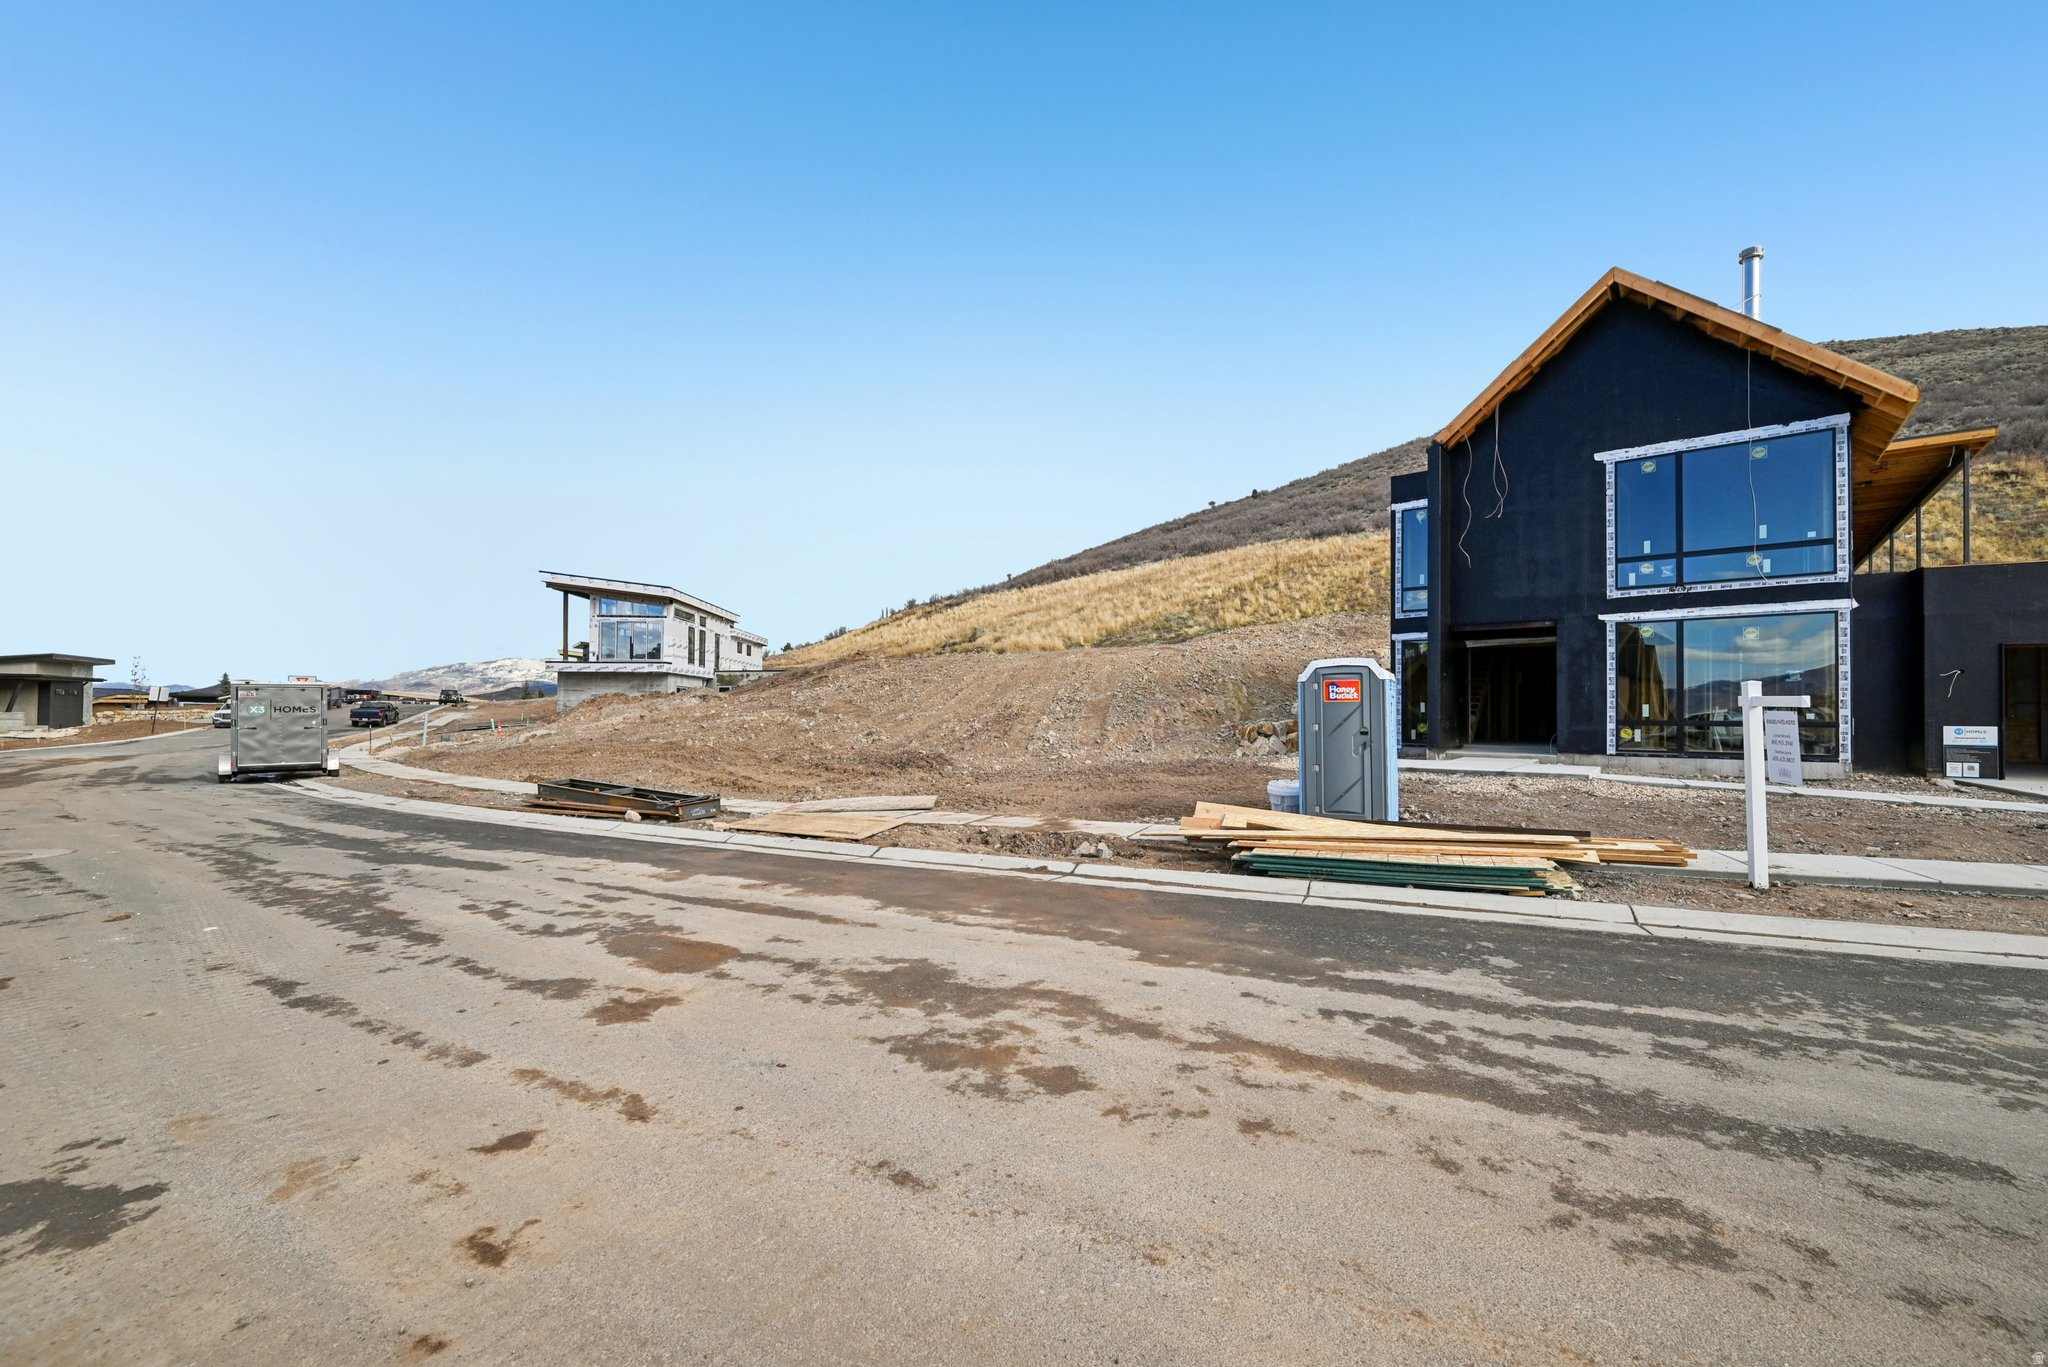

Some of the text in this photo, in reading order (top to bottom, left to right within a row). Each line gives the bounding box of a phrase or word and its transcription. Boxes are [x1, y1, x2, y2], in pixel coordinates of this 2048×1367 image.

[1329, 685, 1356, 693] Honey
[1329, 692, 1359, 700] Bucket
[249, 705, 317, 714] X3 HOMES
